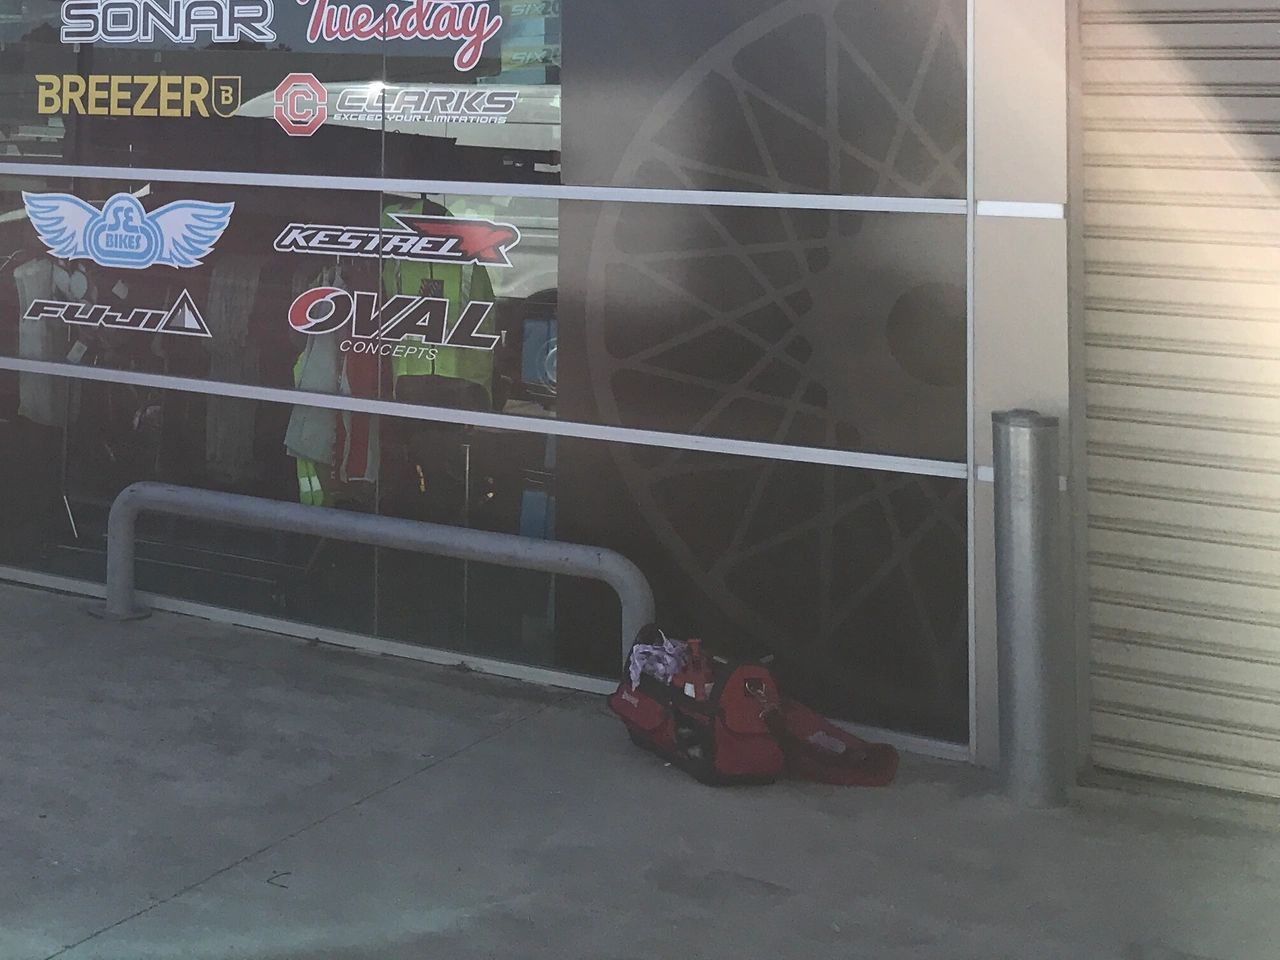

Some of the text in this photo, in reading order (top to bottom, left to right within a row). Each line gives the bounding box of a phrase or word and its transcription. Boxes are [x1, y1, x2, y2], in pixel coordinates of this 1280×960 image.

[35, 75, 209, 117] BREEZER
[336, 89, 520, 114] CLARKS
[333, 113, 508, 124] EXCEED YOUR LIMITATIONS
[105, 233, 141, 250] BIKES
[281, 228, 462, 257] KESTREL
[23, 299, 169, 332] FUJI
[288, 286, 501, 350] OVAL
[340, 340, 439, 360] CONCEPTS
